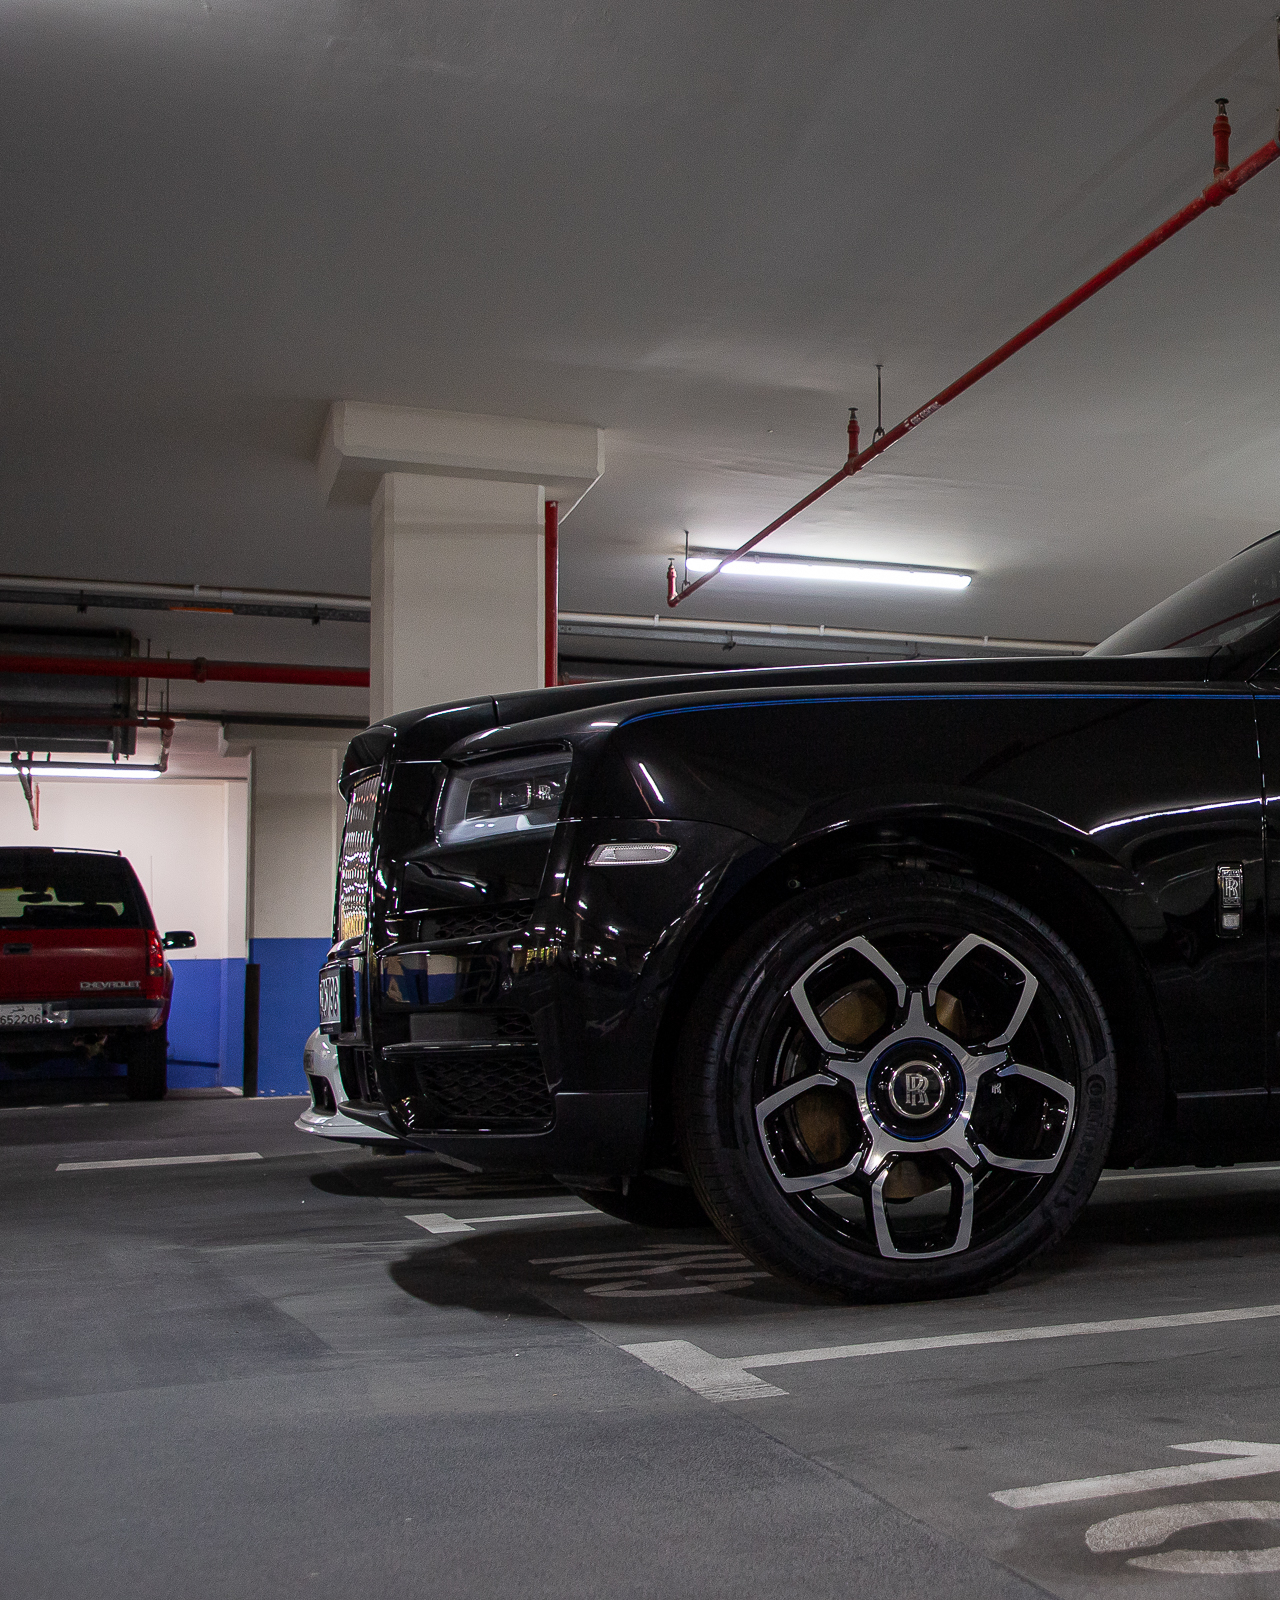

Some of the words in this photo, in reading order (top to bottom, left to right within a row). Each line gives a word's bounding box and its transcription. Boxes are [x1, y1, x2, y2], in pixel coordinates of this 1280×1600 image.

[80, 980, 141, 991] CHEVROLET
[0, 1014, 41, 1025] 652206
[905, 1072, 930, 1106] RR
